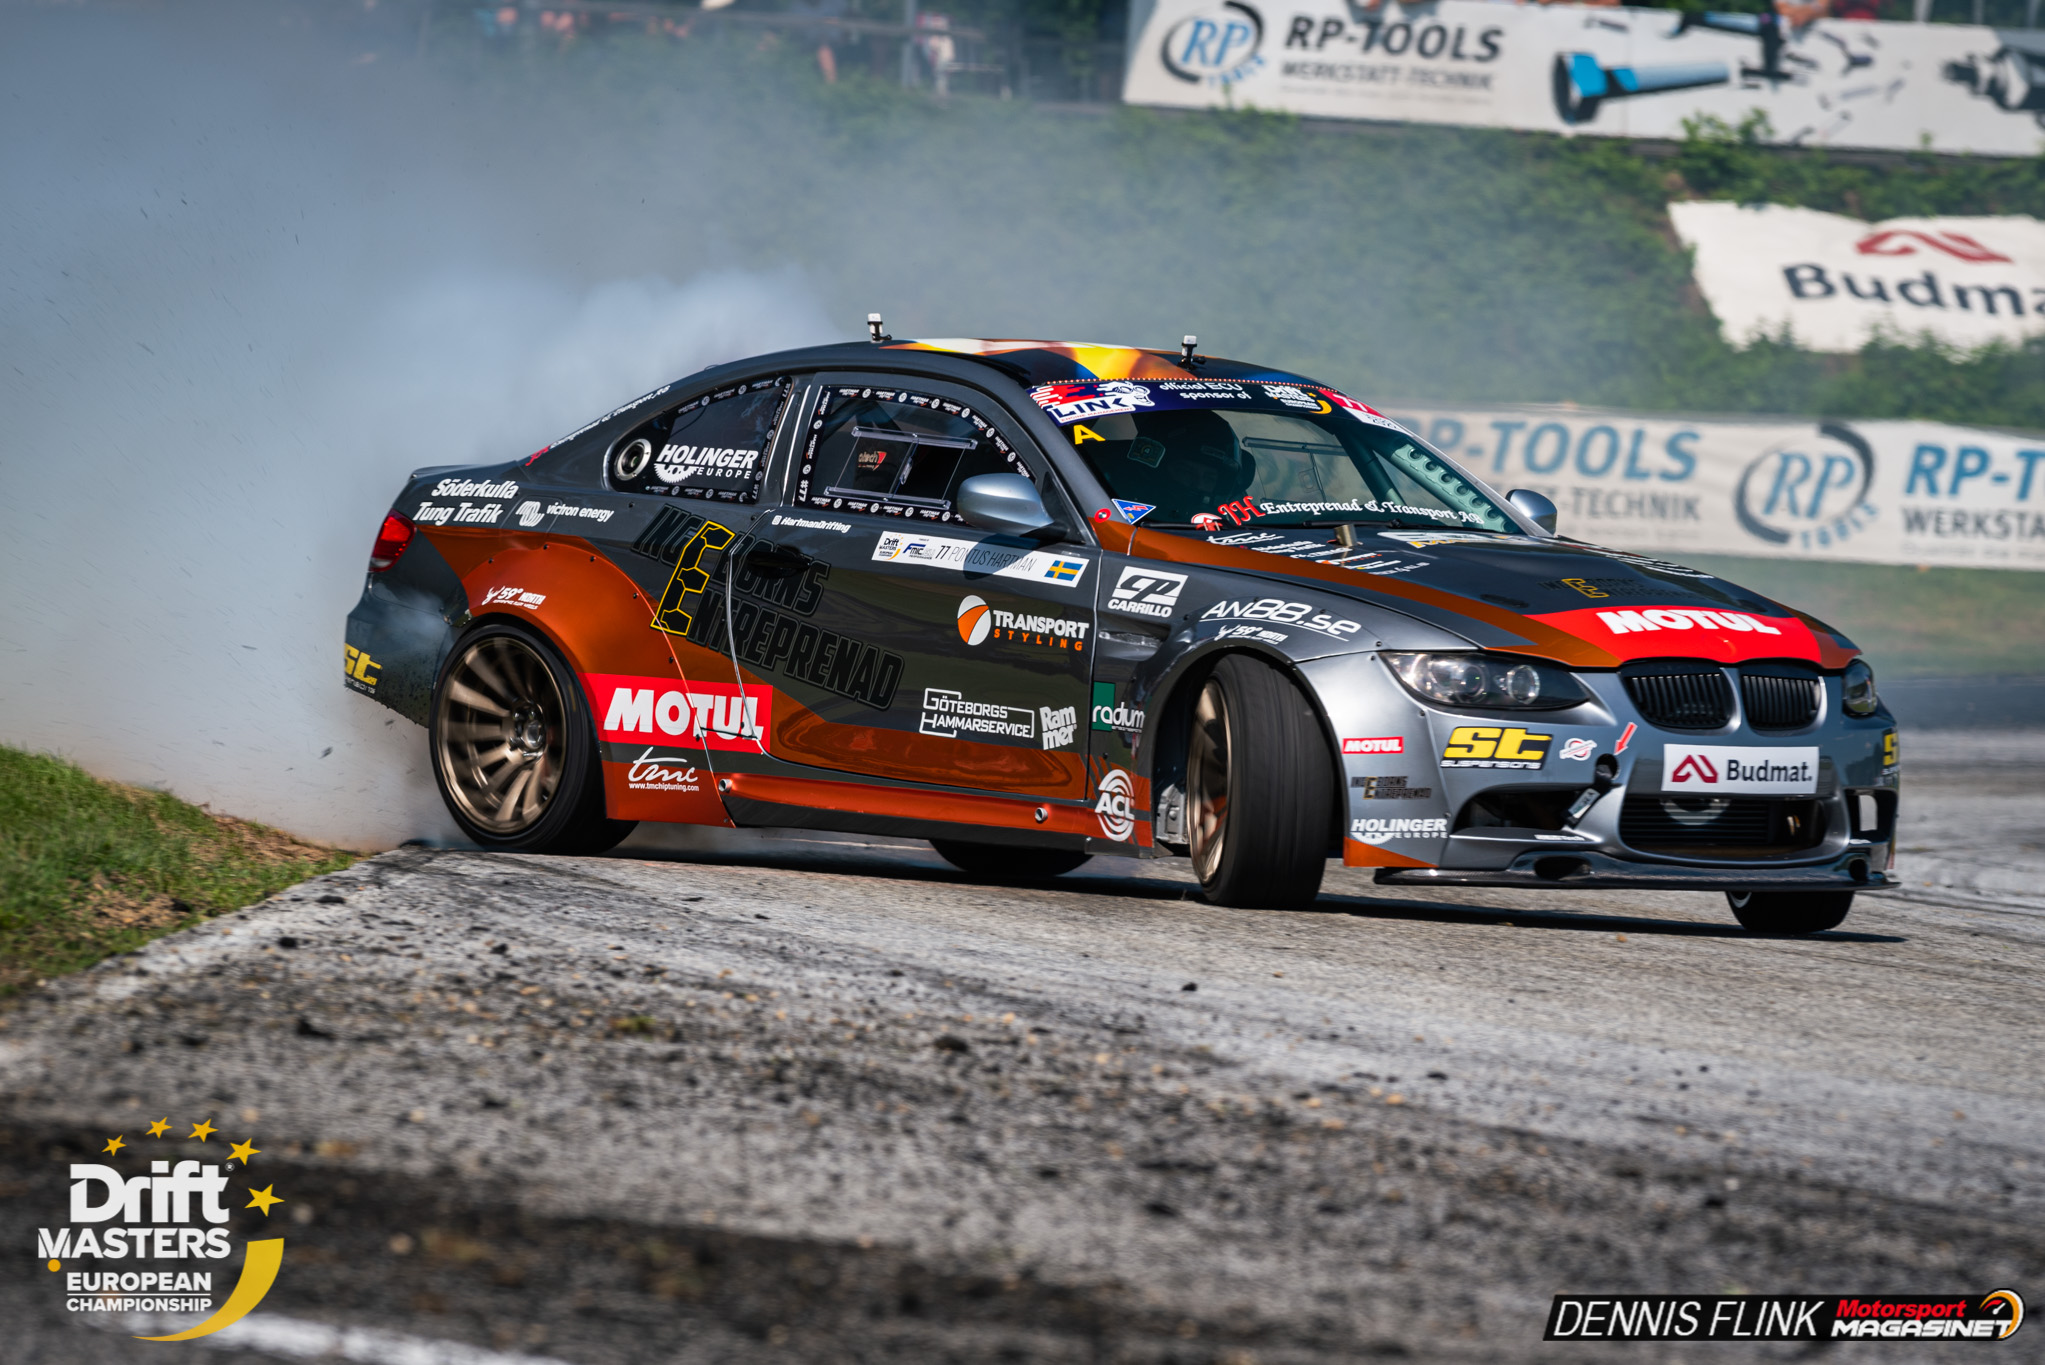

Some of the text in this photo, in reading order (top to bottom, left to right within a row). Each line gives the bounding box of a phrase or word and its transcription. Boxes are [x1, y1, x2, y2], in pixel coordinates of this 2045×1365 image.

[1179, 18, 1252, 67] RP
[1284, 14, 1506, 63] RP-TOOLS
[1159, 382, 1243, 391] official ECU
[1180, 391, 1252, 401] sponsor of
[1051, 397, 1129, 419] LINK
[1073, 424, 1106, 445] A
[656, 444, 759, 469] HOLINGER
[696, 467, 752, 480] EUROPE
[1763, 452, 1856, 520] RP
[431, 477, 519, 499] Söderkulla
[412, 501, 504, 526] Tung Trafik
[546, 502, 614, 523] victron energy
[780, 516, 851, 533] HartmanDrifting
[1260, 499, 1363, 516] Entreprenad
[1381, 501, 1457, 520] Transport
[1458, 511, 1485, 525] AB
[935, 545, 1038, 572] 77 PONTUS HARTMAN
[1107, 598, 1173, 618] CARRILLO
[1200, 598, 1362, 635] AN88.se
[993, 609, 1089, 639] TRANSPORT
[1596, 608, 1782, 636] MOTUL
[993, 628, 1083, 651] STYLING
[603, 687, 765, 741] MOTUL
[923, 692, 1008, 719] GÖTEBORGS
[1039, 706, 1077, 730] Ram
[1092, 701, 1146, 729] radium
[921, 712, 1032, 738] HAMMARSERVICE
[1042, 724, 1077, 750] mer
[1344, 738, 1402, 752] MOTUL
[1726, 758, 1812, 783] Budmat.
[628, 782, 700, 792] www.tmchiptuning.com
[1094, 792, 1135, 821] ACL
[1351, 818, 1448, 832] HOLINGER
[1395, 831, 1448, 839] EUROPE
